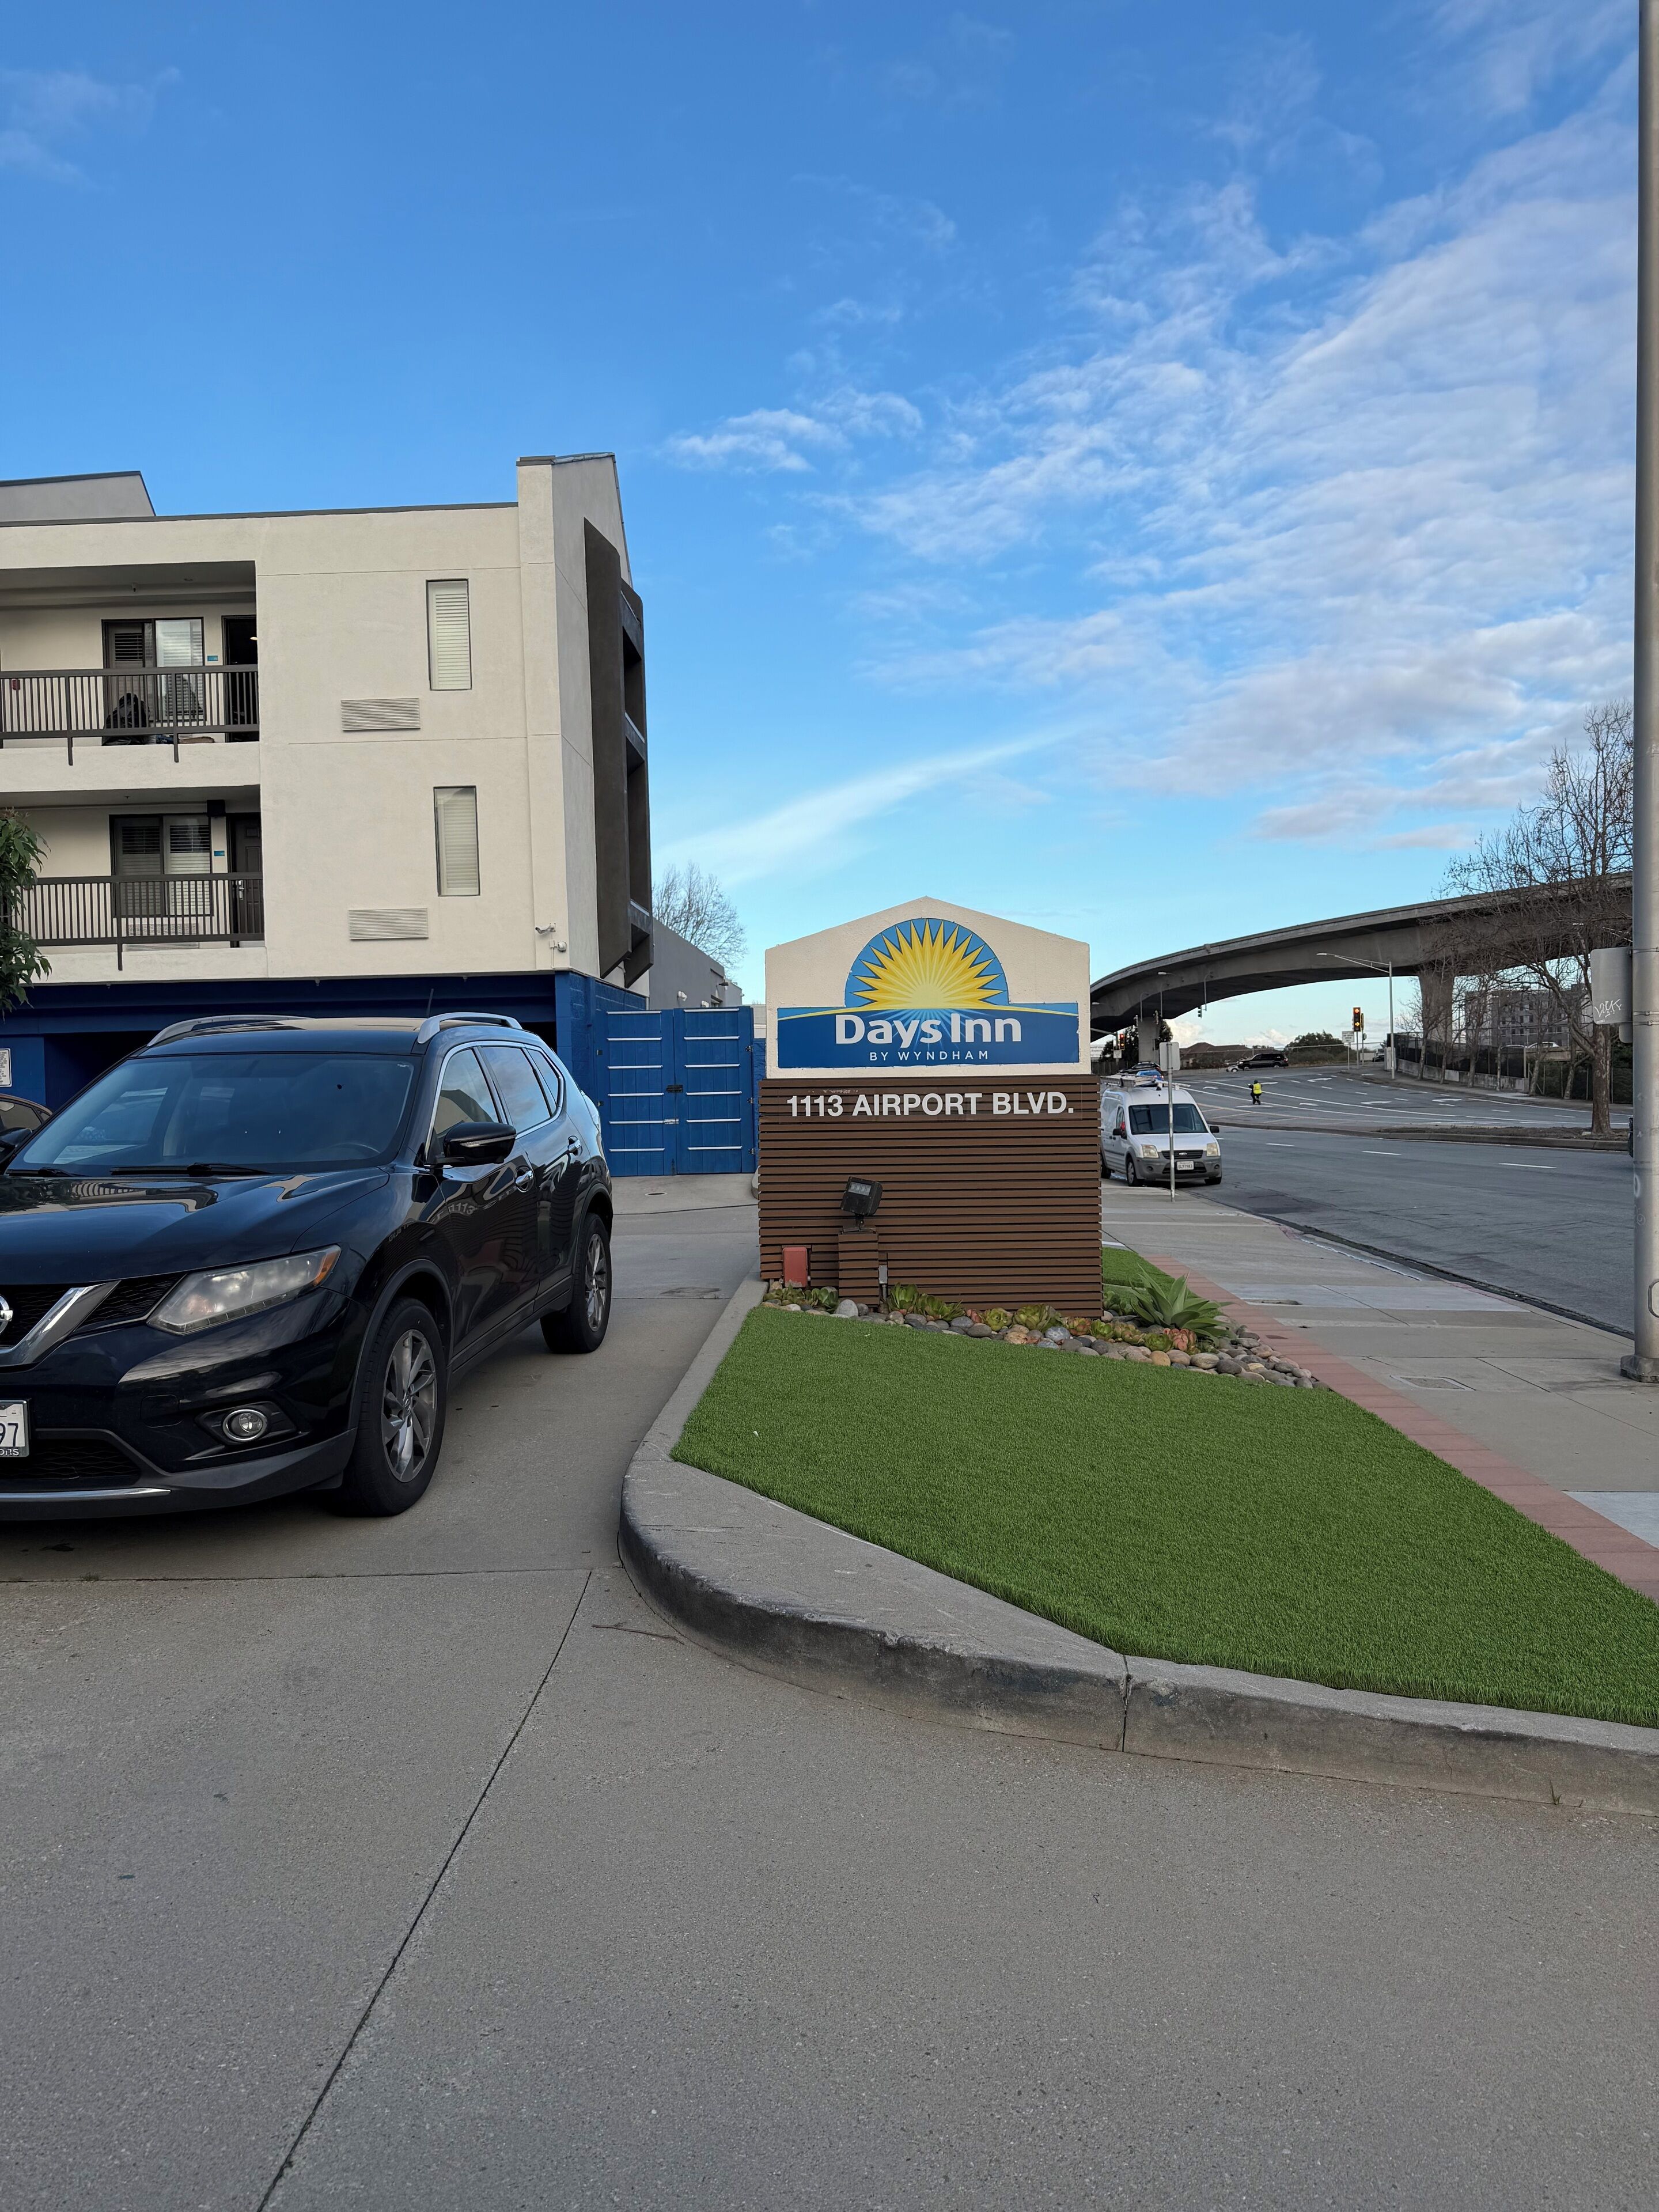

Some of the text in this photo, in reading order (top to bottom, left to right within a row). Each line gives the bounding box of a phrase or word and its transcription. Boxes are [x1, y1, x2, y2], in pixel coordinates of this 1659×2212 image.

[835, 1013, 1021, 1048] Days Inn
[870, 1050, 988, 1060] BY WYNDHAM
[787, 1092, 1074, 1117] 1113 AIRPORT BLVD.
